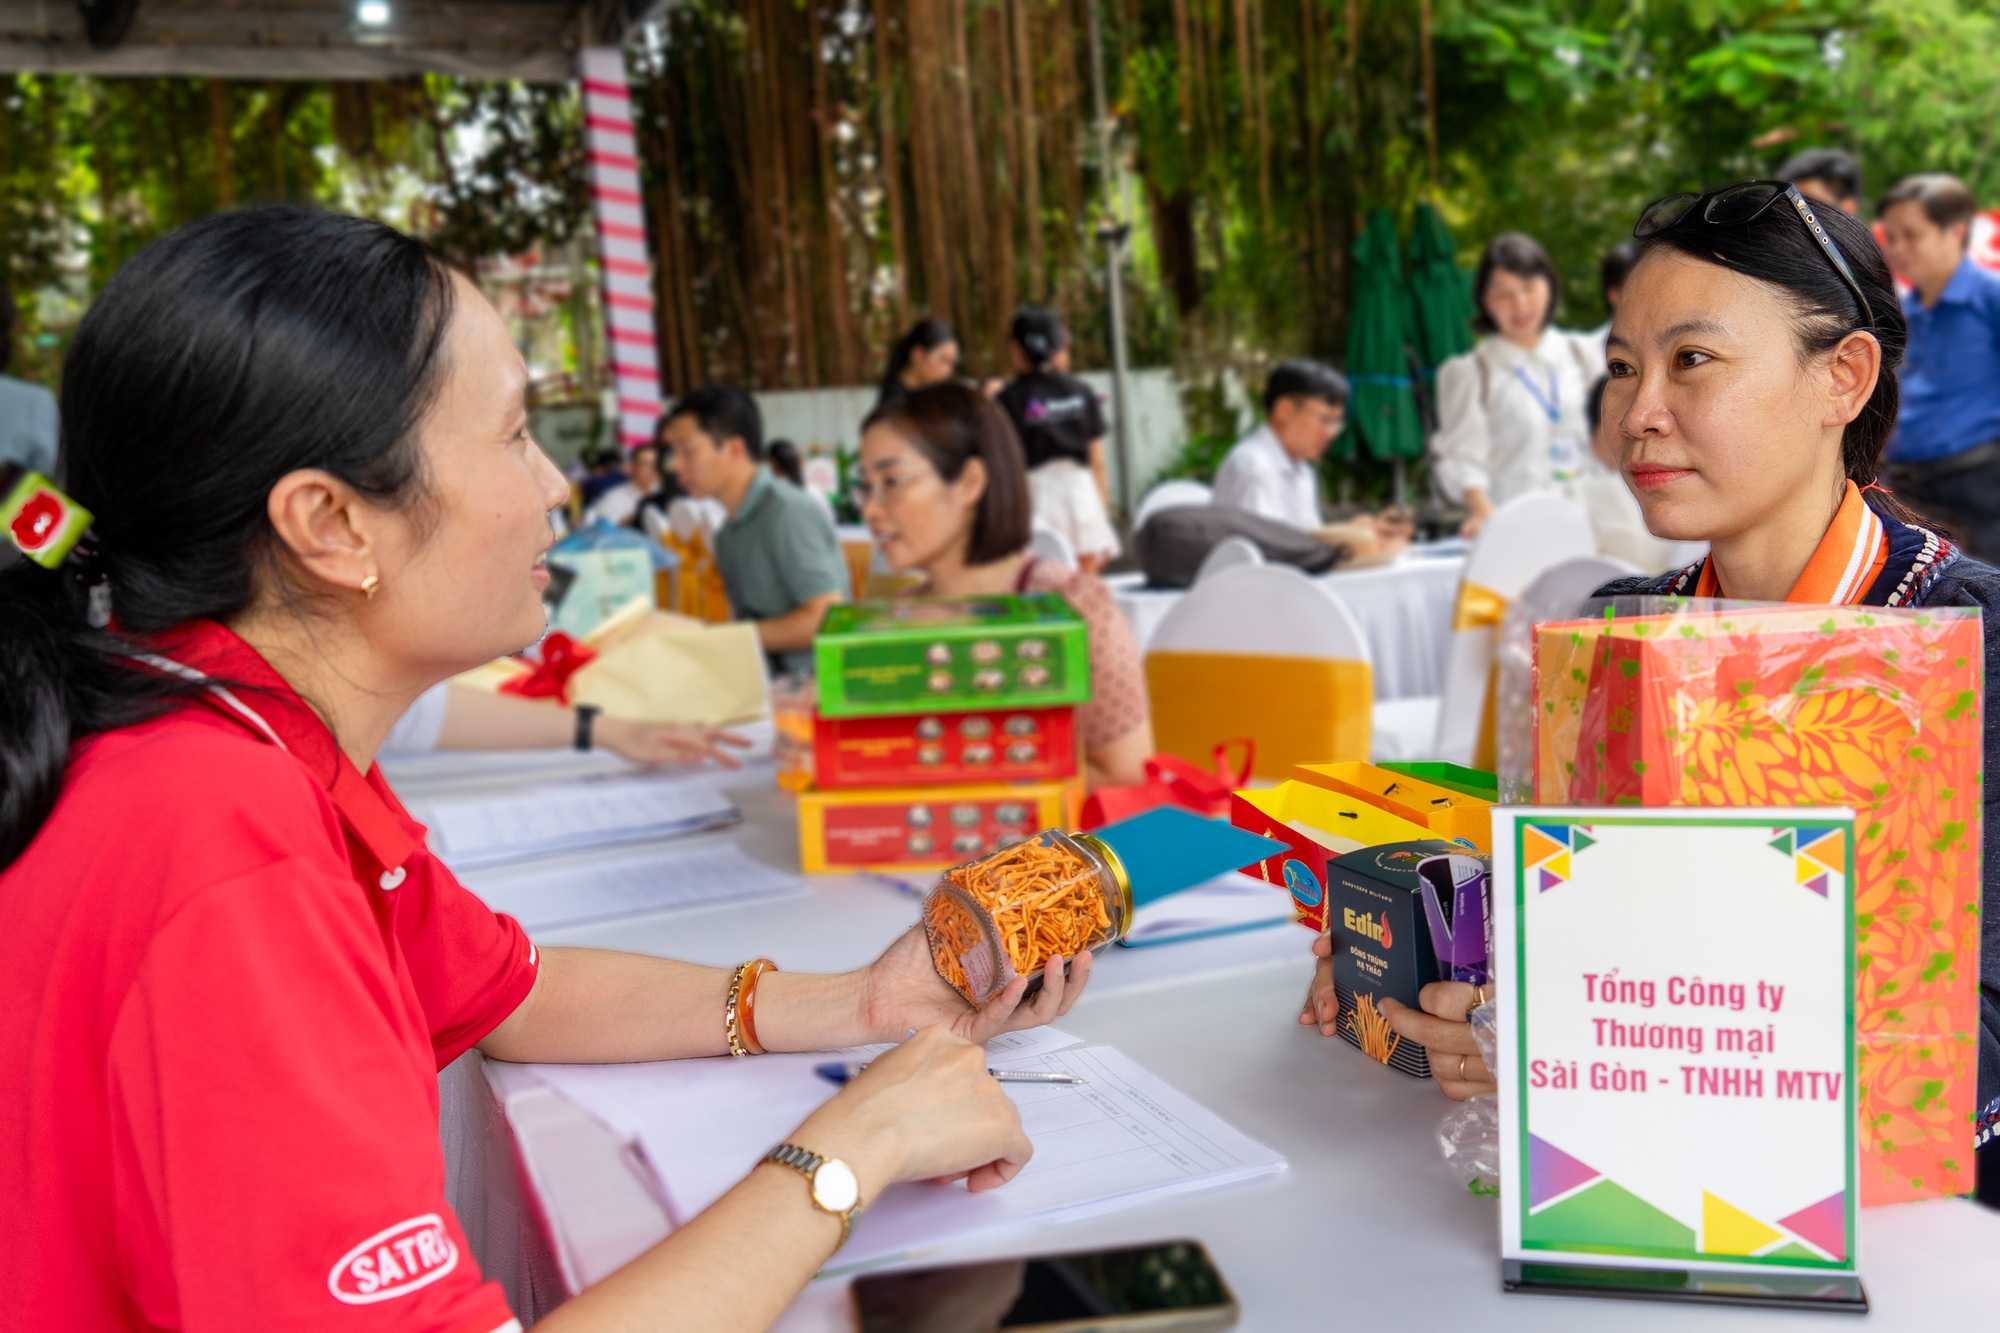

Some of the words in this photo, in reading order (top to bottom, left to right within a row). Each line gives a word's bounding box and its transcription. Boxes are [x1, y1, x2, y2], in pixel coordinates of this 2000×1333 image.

[1583, 968, 1655, 1009] Tổng
[1668, 976, 1746, 1012] Công
[1758, 981, 1785, 1013] ty
[1592, 1018, 1704, 1055] Thương
[1716, 1024, 1775, 1060] mại
[1530, 1060, 1578, 1090] Sài
[1590, 1062, 1647, 1093] Gòn
[1680, 1066, 1764, 1098] TNHH
[1777, 1070, 1843, 1102] MTV
